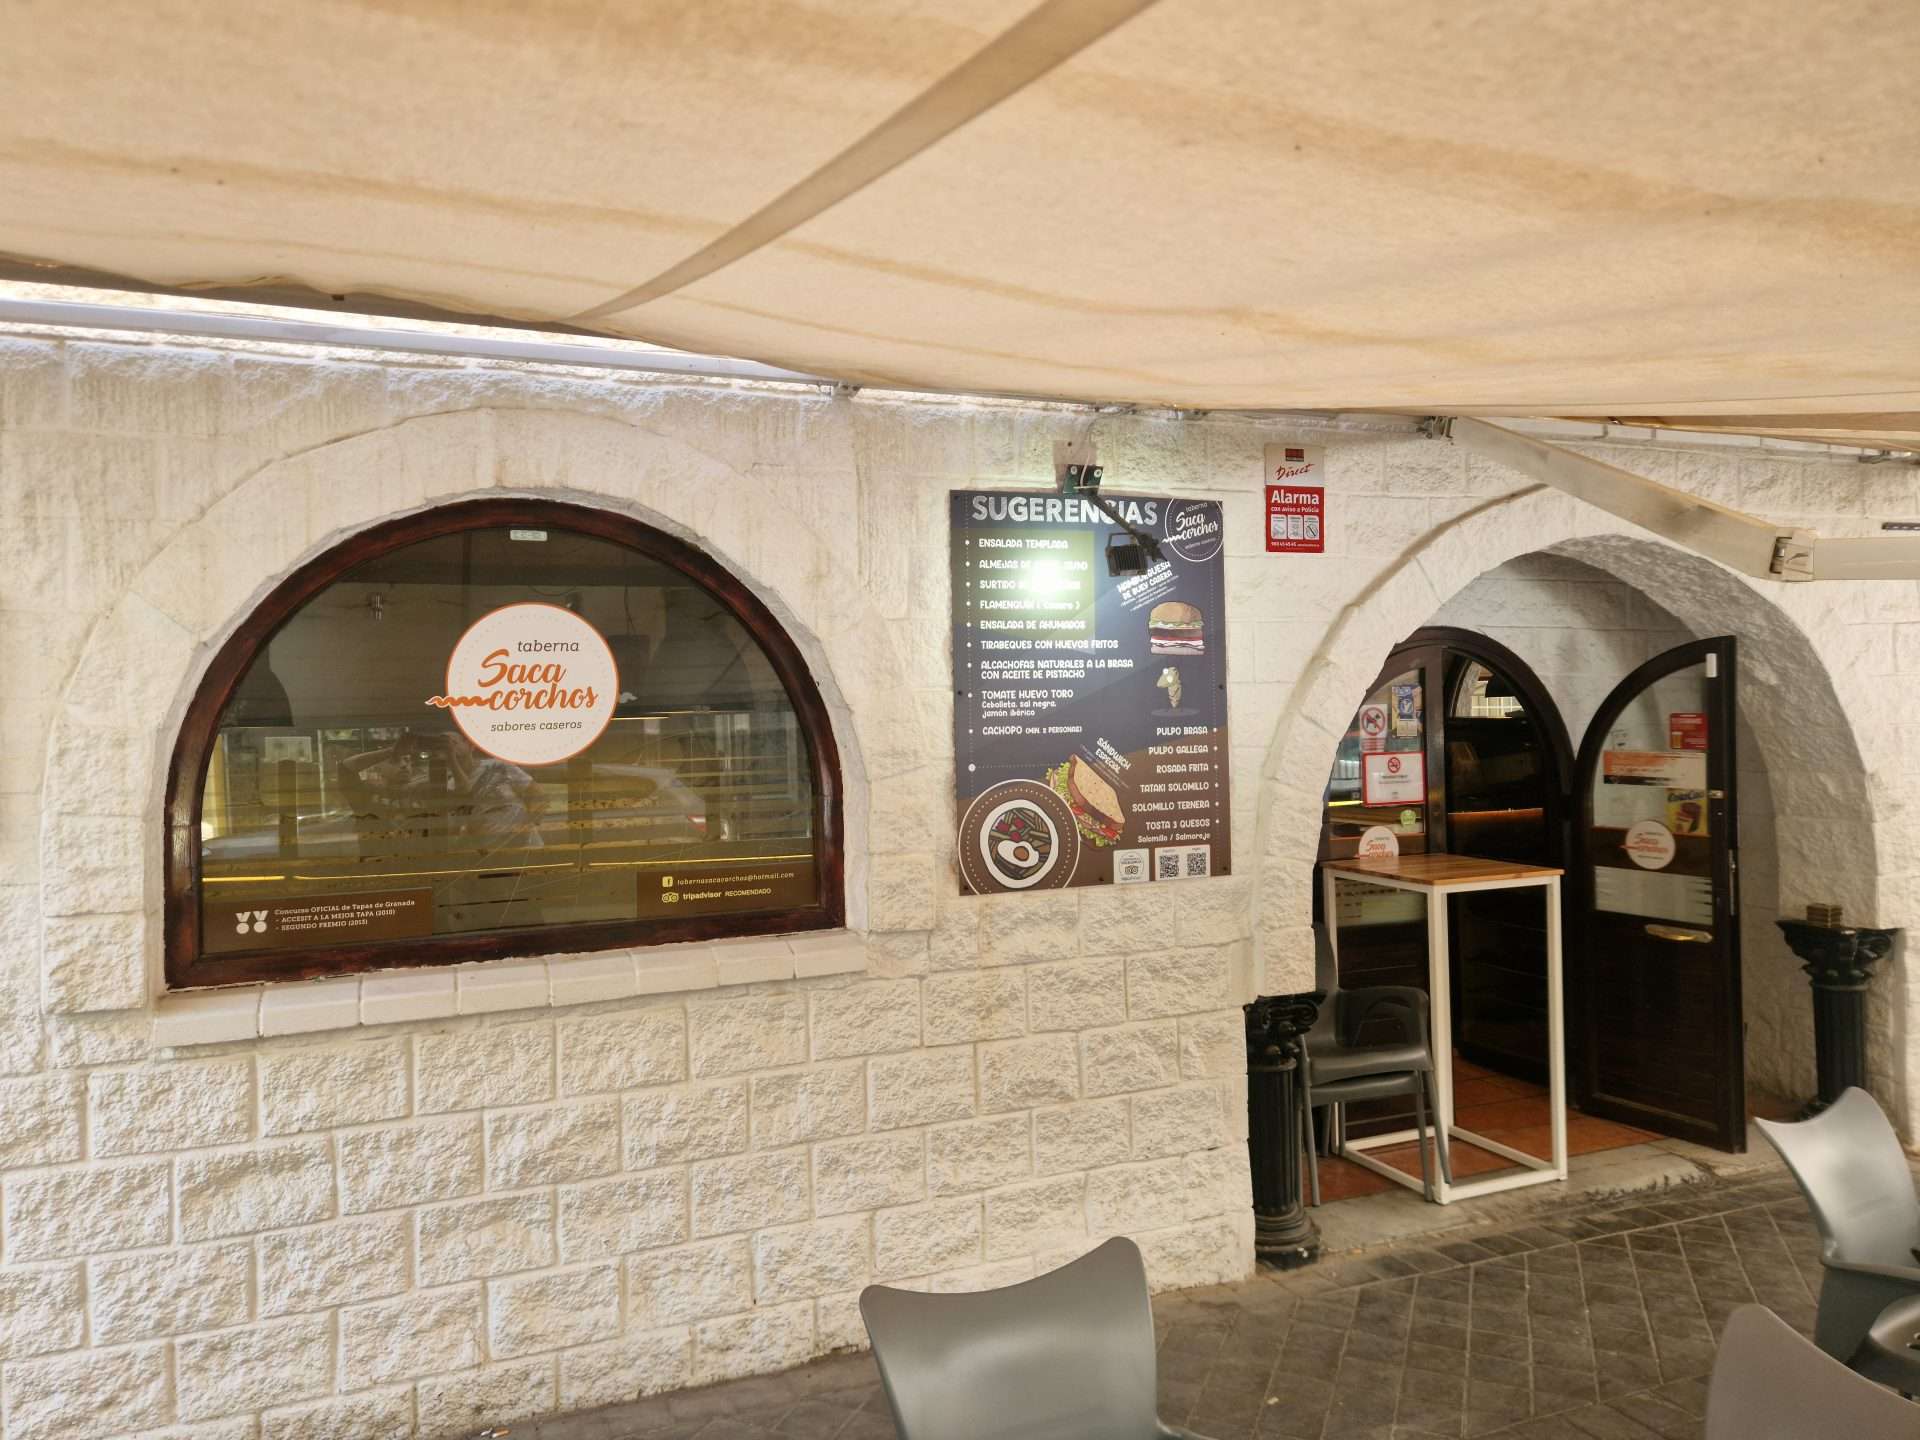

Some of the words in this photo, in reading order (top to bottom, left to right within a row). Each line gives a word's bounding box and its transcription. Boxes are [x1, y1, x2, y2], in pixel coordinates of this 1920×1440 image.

[1271, 489, 1319, 504] Alarma
[972, 495, 1157, 526] SUGERENCIAS
[1175, 511, 1206, 531] Saca
[1181, 520, 1218, 541] corchos
[979, 538, 1023, 548] ENSALADA
[979, 559, 1019, 569] ALMEJAS
[979, 579, 1016, 590] SURTIDO
[980, 620, 1024, 630] ENSALADA
[1026, 620, 1038, 630] DE
[1039, 620, 1087, 630] AHUMADOS
[517, 639, 579, 652] taberna
[981, 640, 1032, 650] TIRABEQUES
[1034, 640, 1053, 649] CON
[1055, 640, 1089, 649] HUEVOS
[1091, 640, 1119, 649] FRITOS
[478, 648, 566, 688] Saca
[981, 660, 1035, 670] ALCACHOFAS
[1037, 659, 1084, 669] NATURALES
[1086, 659, 1093, 668] A
[1095, 659, 1106, 668] LA
[1107, 659, 1134, 668] BRASA
[981, 670, 1000, 680] CON
[1002, 670, 1030, 679] ACEITE
[1032, 670, 1043, 679] DE
[1045, 669, 1085, 679] PISTACHO
[489, 683, 598, 711] corchos
[981, 690, 1016, 699] TOMATE
[1018, 690, 1048, 699] HUEVO
[1051, 689, 1074, 698] TORO
[1019, 700, 1031, 708] sal
[490, 720, 536, 732] sabores
[539, 720, 582, 731] caseros
[982, 726, 1023, 735] CACHOPO
[1156, 727, 1181, 736] PULPO
[1183, 726, 1208, 735] BRASA
[1148, 745, 1174, 755] PULPO
[1176, 745, 1209, 754] GALLEGA
[1156, 764, 1187, 774] ROSADA
[1188, 763, 1209, 772] FRITA
[1140, 783, 1166, 793] TATAKI
[1168, 782, 1209, 792] SOLOMILLO
[1132, 801, 1175, 812] SOLOMILLO
[1177, 800, 1210, 809] TERNERA
[1145, 821, 1171, 831] TOSTA
[1180, 819, 1210, 829] QUESOS
[683, 891, 722, 901] tripadvisor
[724, 888, 772, 897] RECOMENDADO
[310, 905, 340, 913] OFICIAL
[352, 903, 373, 911] Tapas
[385, 899, 415, 907] Granada
[281, 922, 317, 931] SEGUNDO
[318, 920, 347, 928] PREMIO
